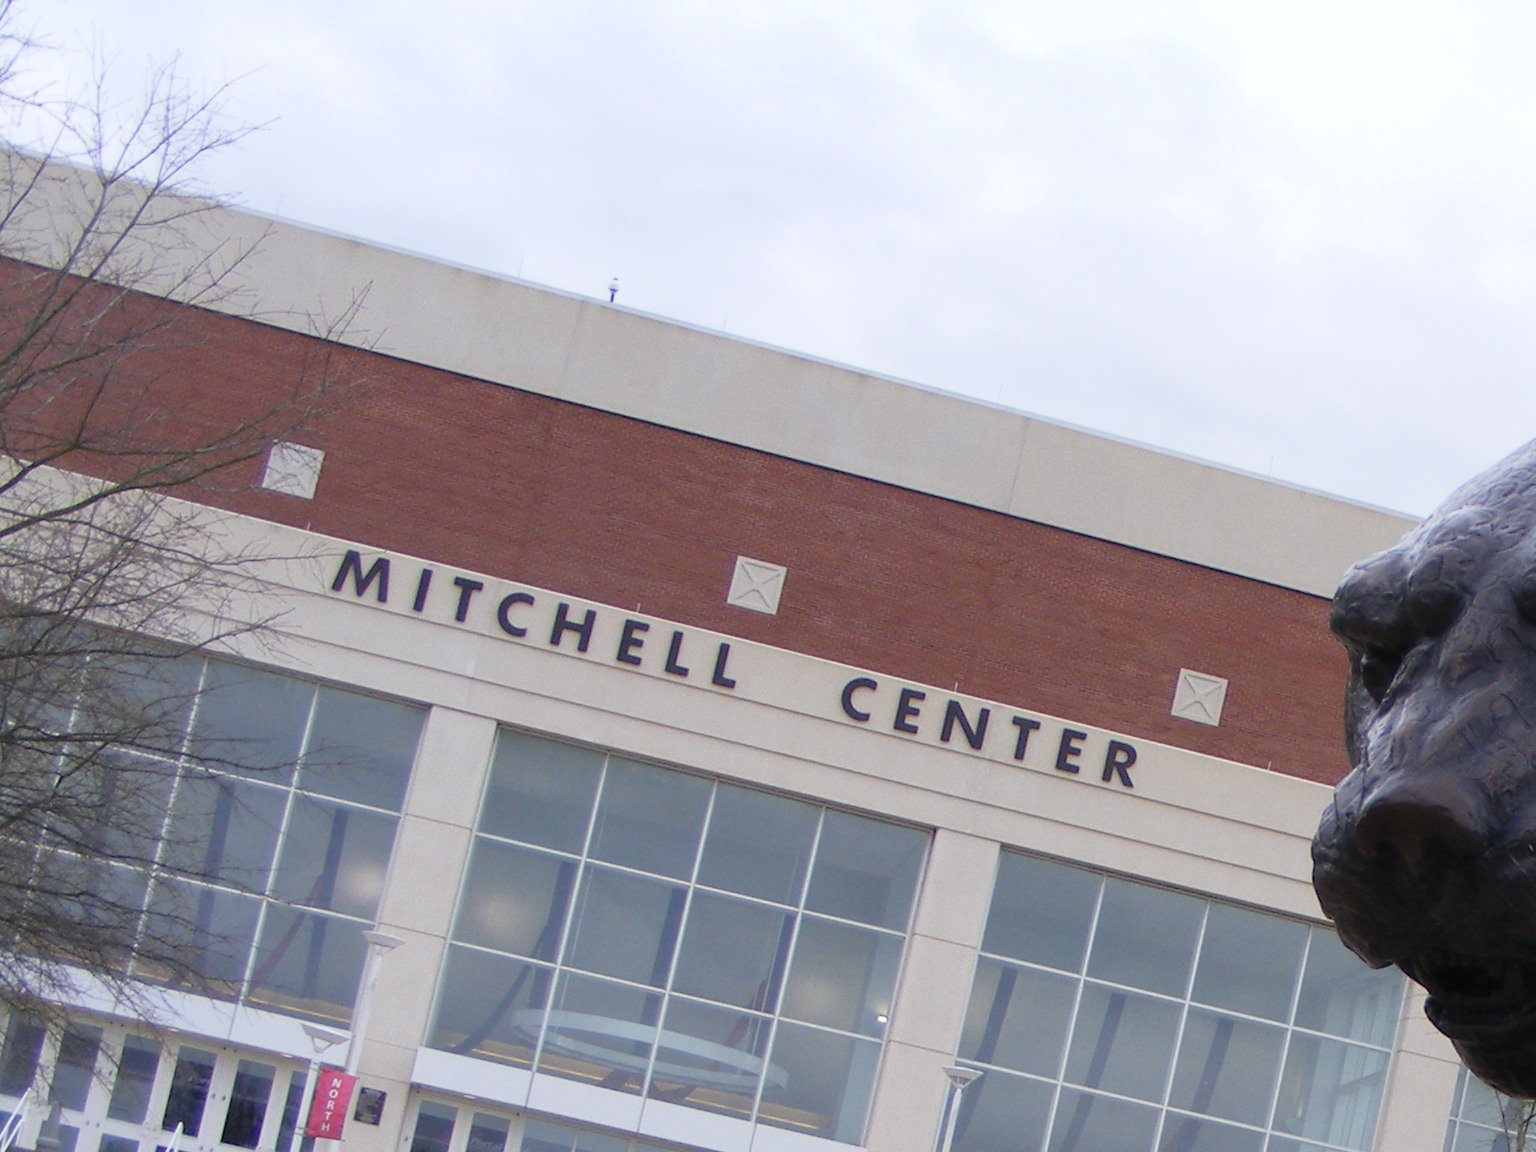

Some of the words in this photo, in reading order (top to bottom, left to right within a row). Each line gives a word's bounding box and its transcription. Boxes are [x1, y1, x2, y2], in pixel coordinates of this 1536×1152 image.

[331, 549, 737, 689] MITCHELL
[840, 676, 1138, 788] CENTER
[321, 1078, 342, 1132] NORTH
